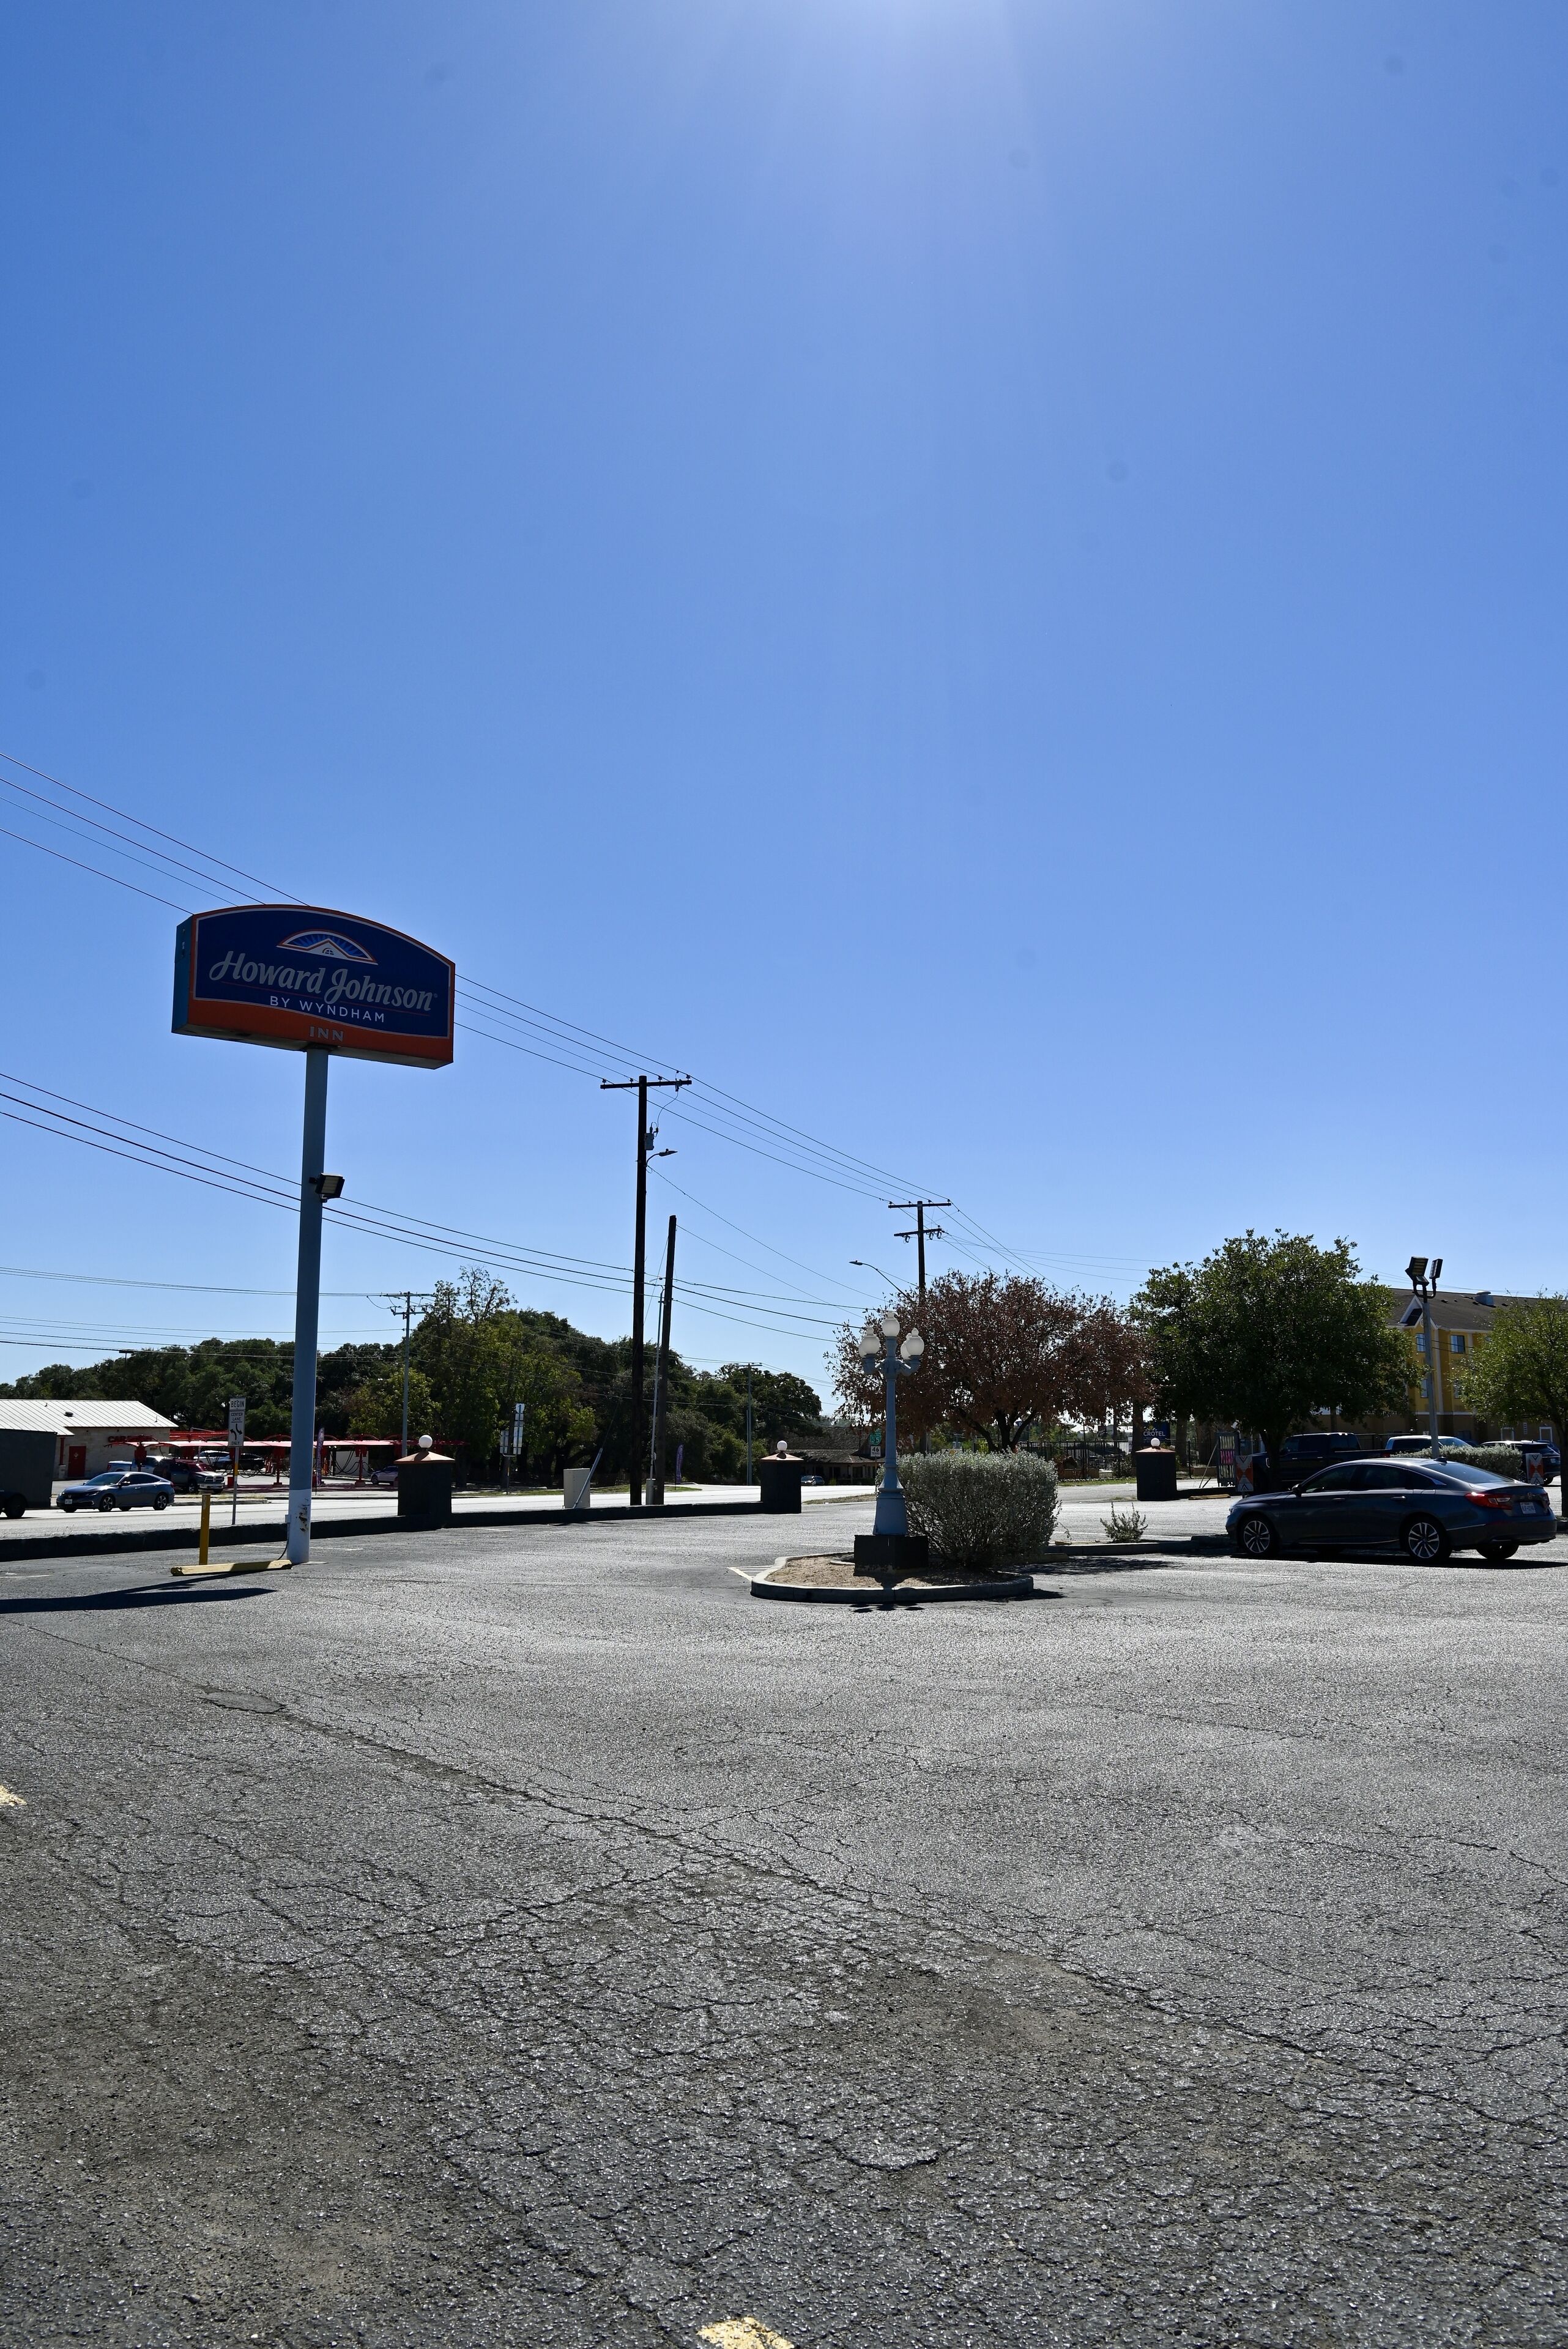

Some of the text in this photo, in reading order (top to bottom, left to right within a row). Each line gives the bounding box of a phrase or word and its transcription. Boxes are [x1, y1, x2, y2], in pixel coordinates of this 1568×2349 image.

[209, 951, 433, 1011] Howard Johnson
[270, 995, 384, 1023] BY WYNDHAM
[309, 1026, 344, 1042] INN
